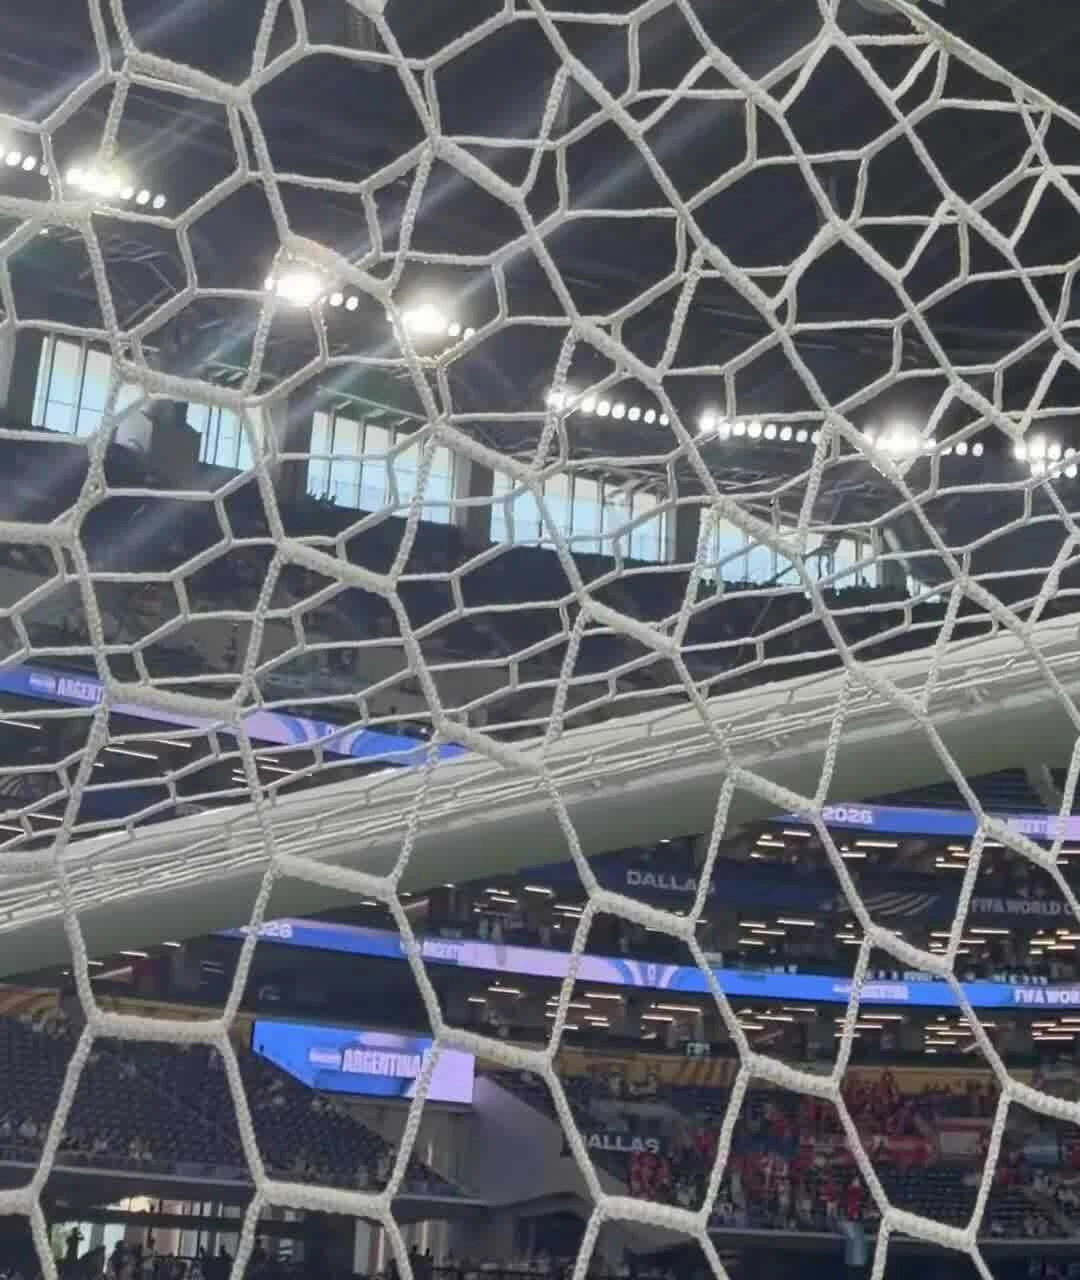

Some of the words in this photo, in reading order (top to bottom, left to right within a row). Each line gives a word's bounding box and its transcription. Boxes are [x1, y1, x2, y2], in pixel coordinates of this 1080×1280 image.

[822, 806, 873, 824] 2026
[1014, 989, 1045, 1004] FIFA
[575, 1133, 660, 1153] ALLAS
